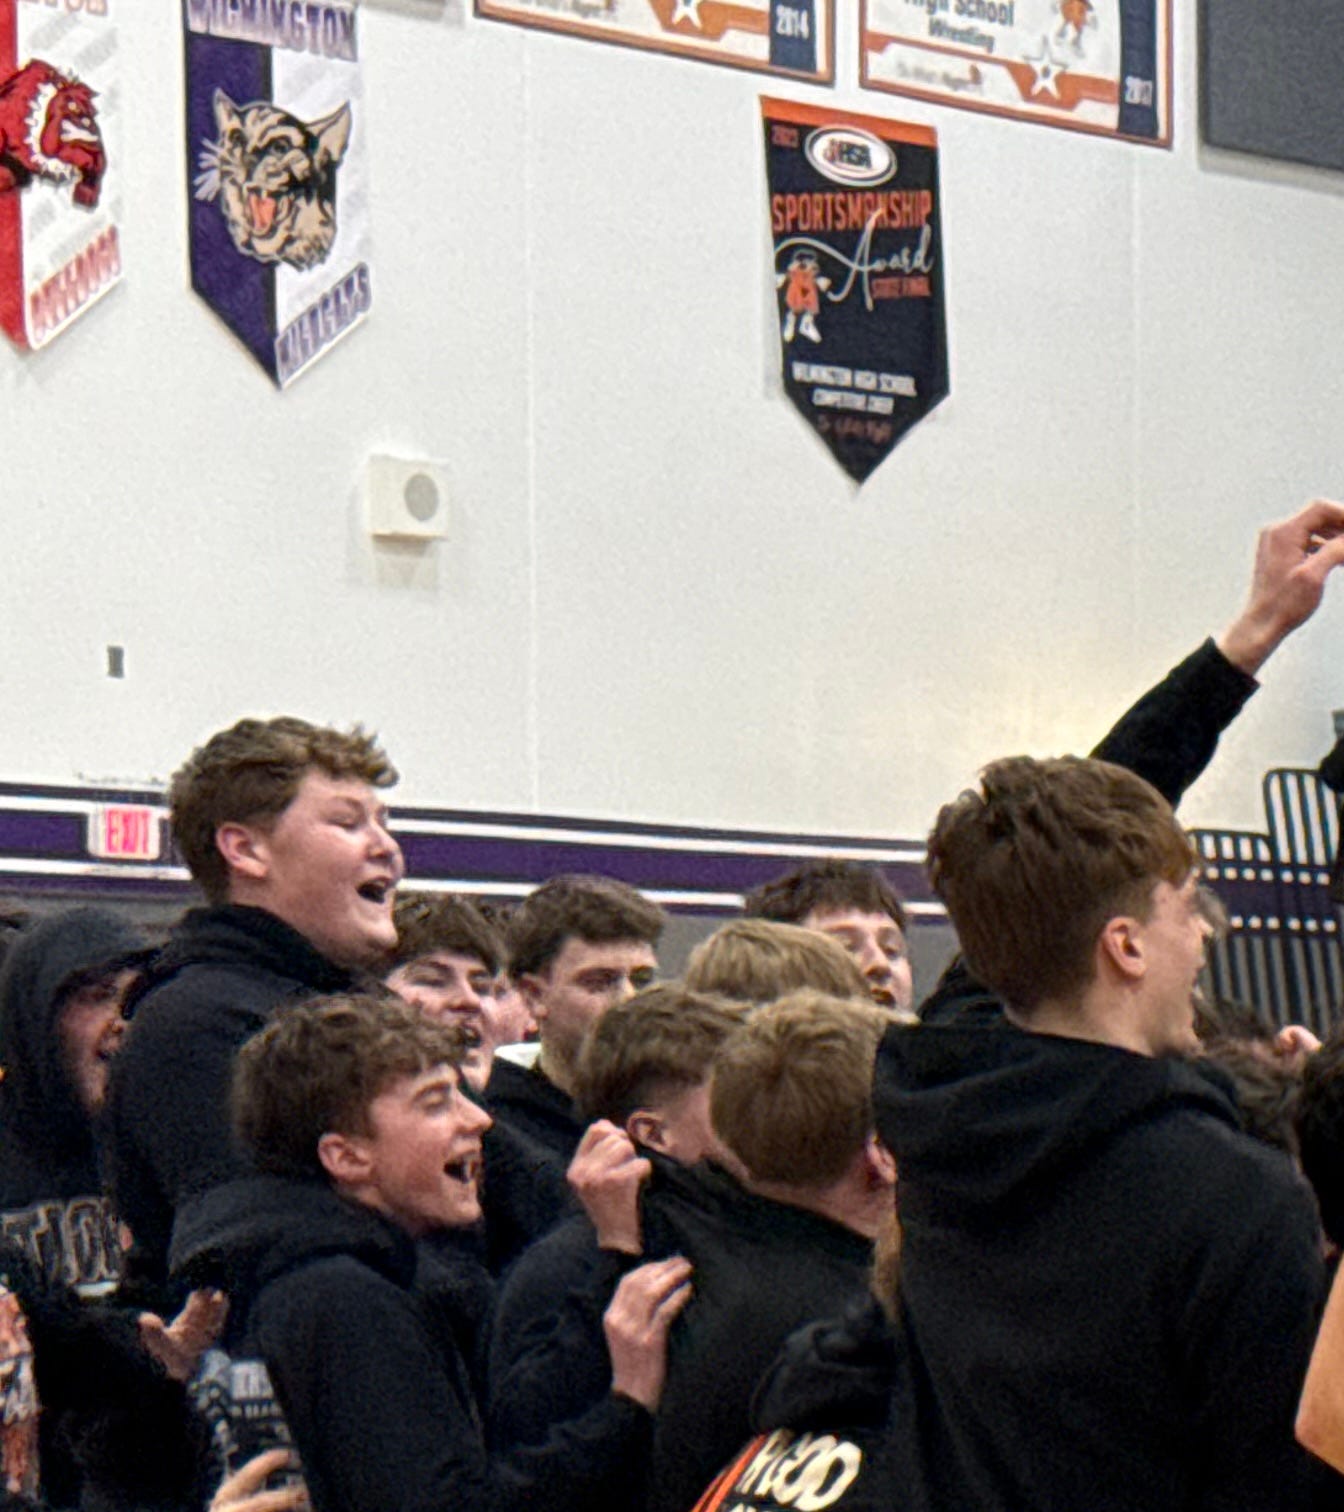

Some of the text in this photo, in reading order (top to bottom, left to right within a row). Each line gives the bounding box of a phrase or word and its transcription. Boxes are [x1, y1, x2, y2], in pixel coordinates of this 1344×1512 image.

[775, 5, 808, 39] 2014
[772, 189, 932, 231] SPORTSMANSHIP
[105, 808, 150, 856] EXIT
